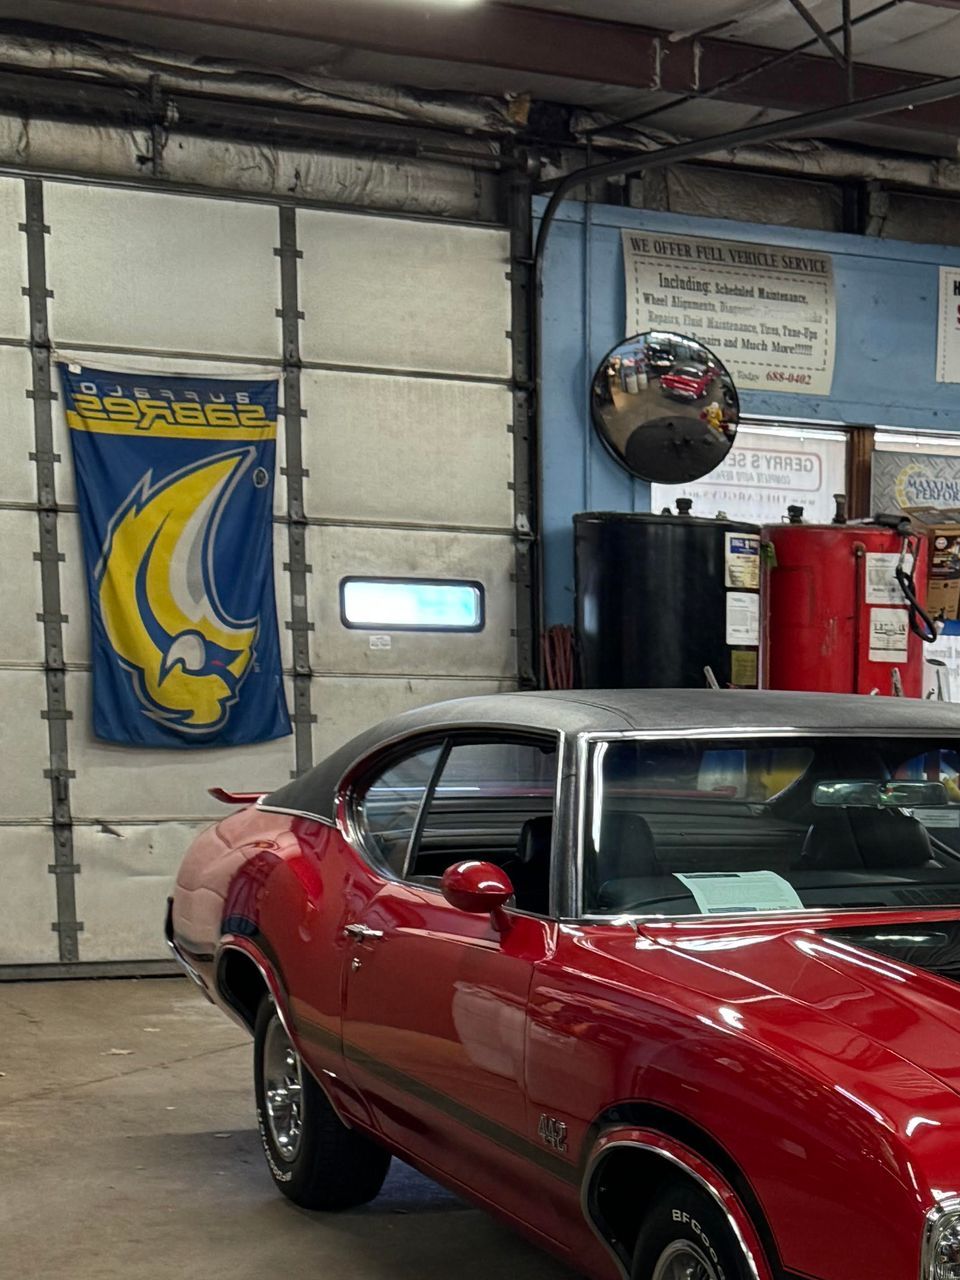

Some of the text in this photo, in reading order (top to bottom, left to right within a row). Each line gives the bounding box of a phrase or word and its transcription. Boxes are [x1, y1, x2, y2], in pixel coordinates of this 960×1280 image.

[630, 236, 828, 274] WE OFFER FULL VEHICLE SERVICE
[658, 273, 712, 296] Including:
[715, 282, 754, 298] Scheduled
[643, 292, 668, 307] Wheel
[782, 325, 818, 342] Tune-Ups
[724, 336, 738, 349] and
[741, 338, 768, 352] Much
